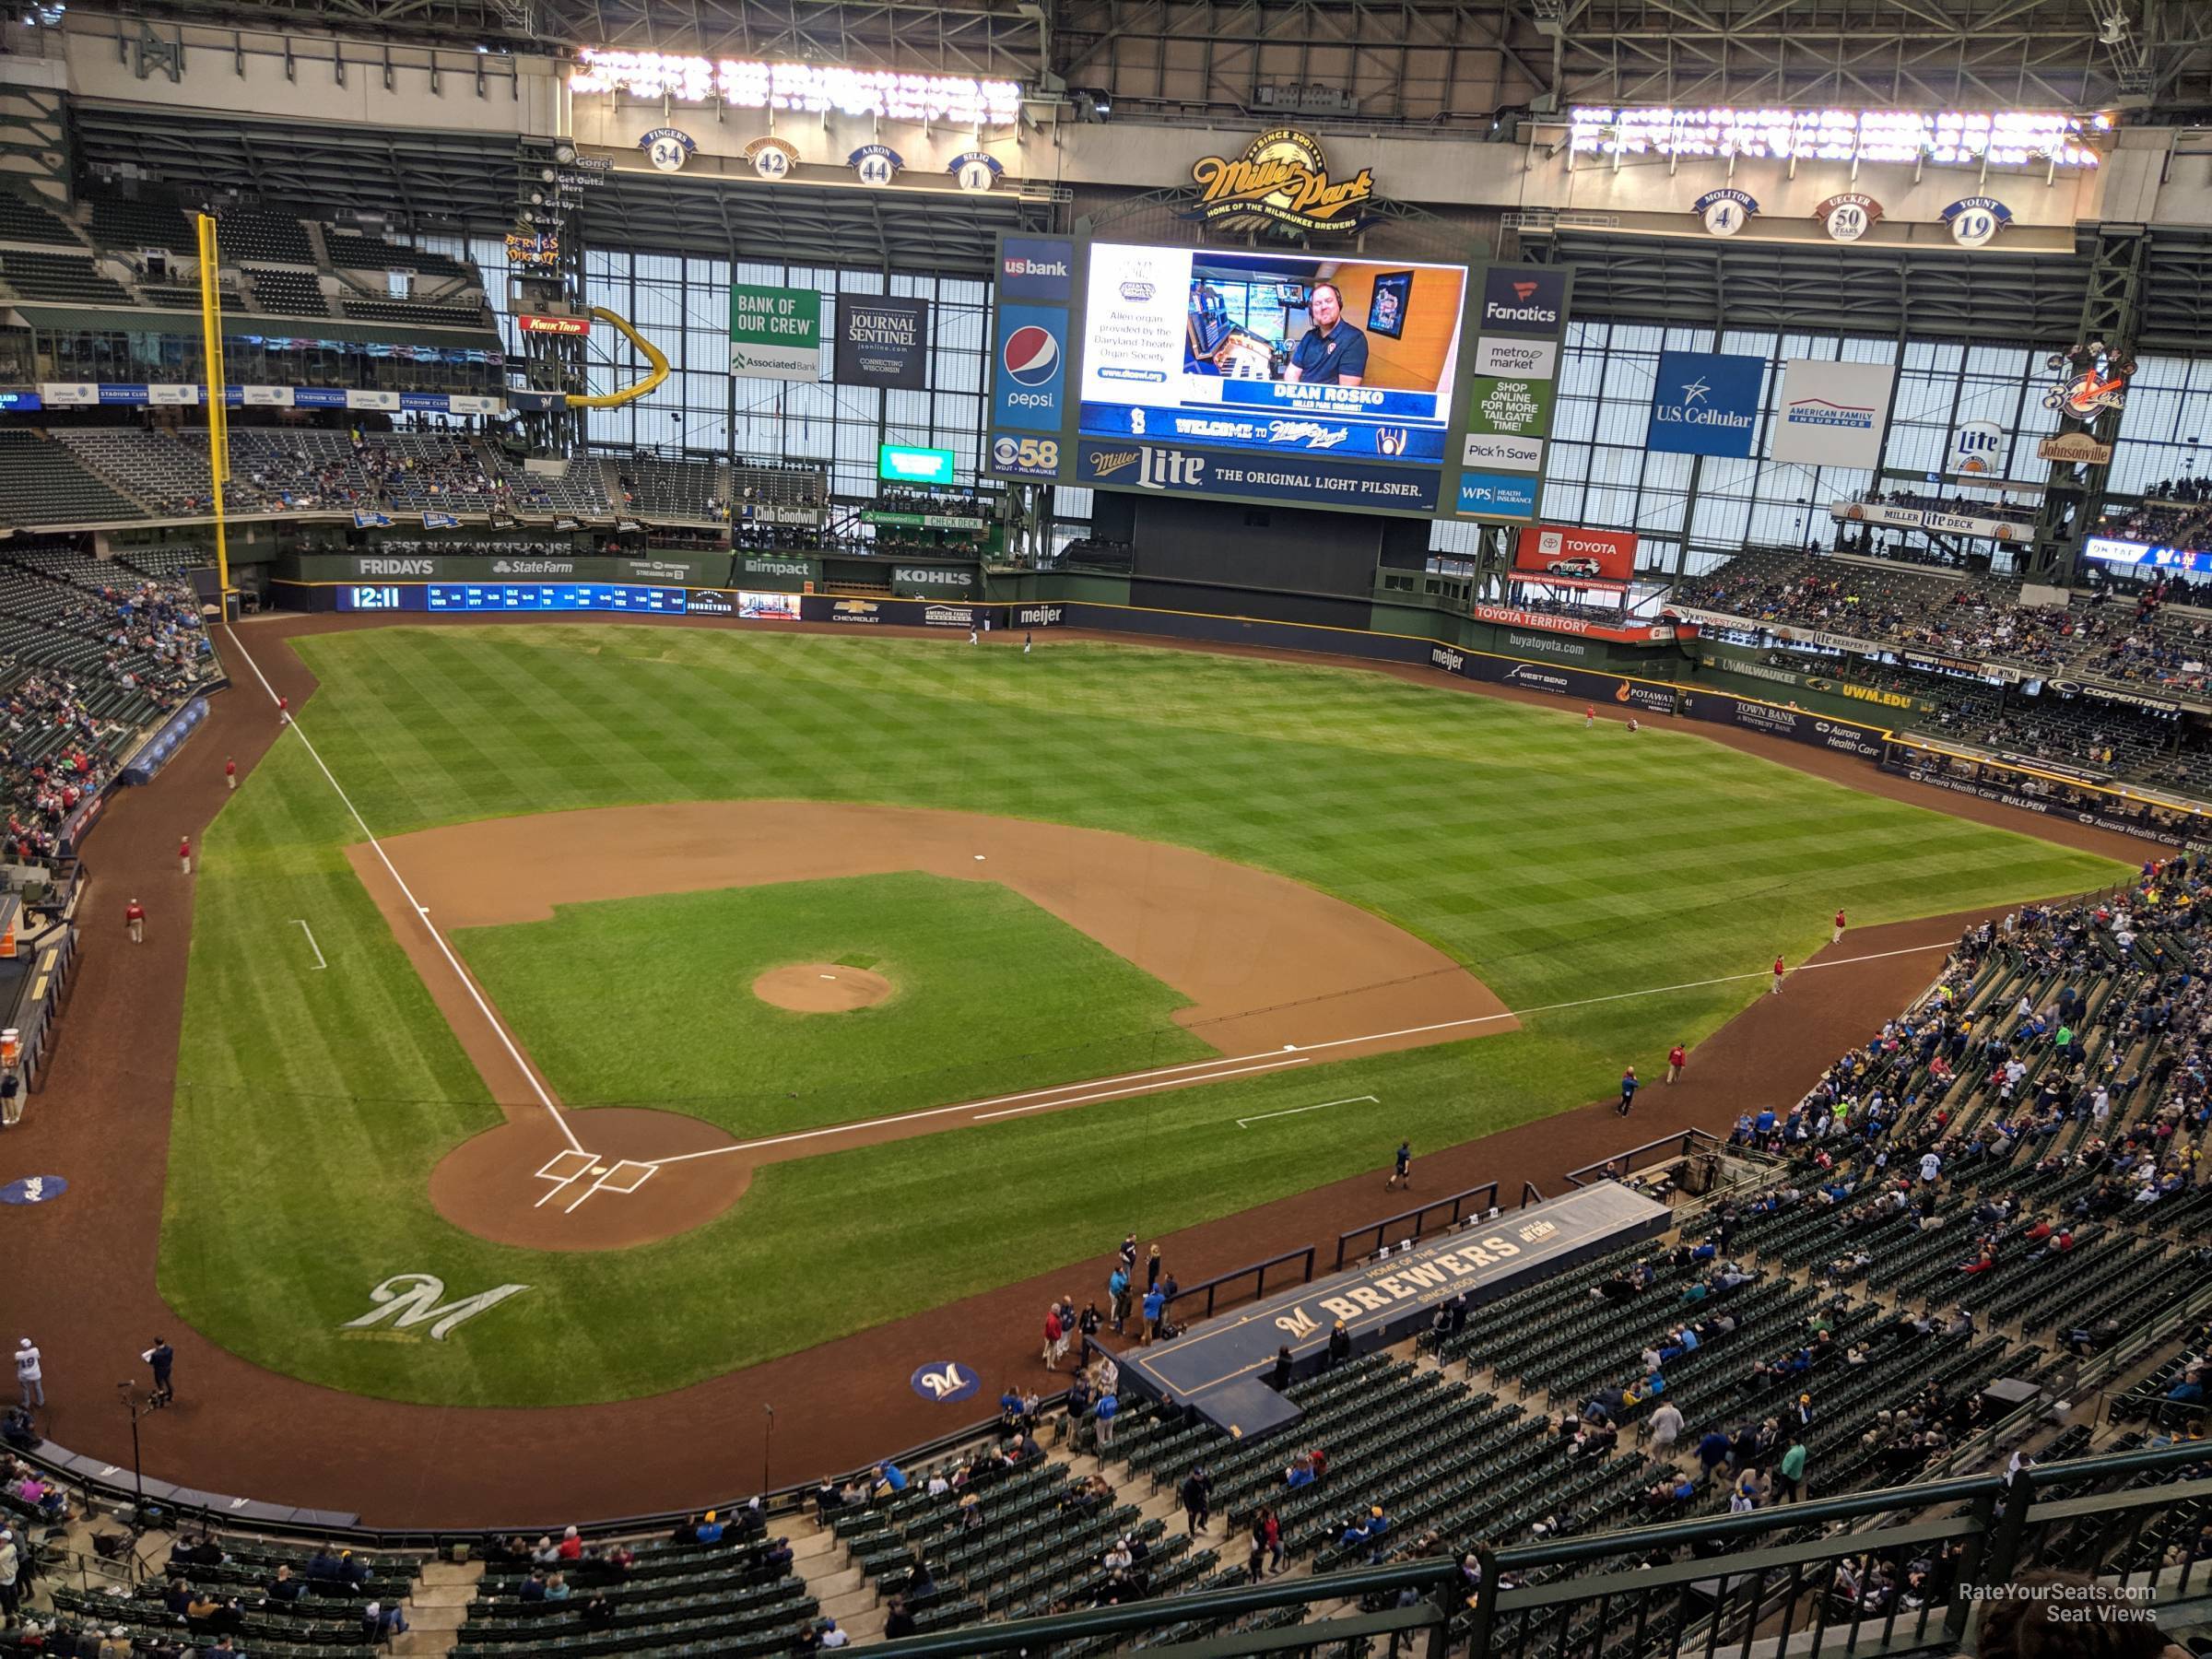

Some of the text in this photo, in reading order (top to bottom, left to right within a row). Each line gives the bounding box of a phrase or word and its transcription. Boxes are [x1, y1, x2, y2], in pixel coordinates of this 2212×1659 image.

[649, 129, 687, 142] FINGERS
[1257, 132, 1314, 149] SINCE 2001
[751, 138, 793, 152] ROBINSON
[863, 146, 891, 158] AARON
[655, 145, 681, 164] 34
[759, 153, 784, 173] 42
[963, 152, 990, 162] SELIG
[863, 160, 888, 182] 44
[971, 170, 982, 189] 1
[558, 175, 605, 186] Get Outta
[561, 184, 584, 193] Here
[1194, 156, 1374, 215] Miller Park
[562, 201, 574, 210] Up
[1705, 190, 1750, 205] MOLITOR
[1830, 194, 1871, 206] UECKER
[1959, 198, 1998, 209] YOUNT
[1207, 203, 1357, 229] HOME OF THE MILWAUKEE BREWERS
[1715, 206, 1730, 228] 4
[1835, 209, 1860, 228] 50
[1959, 216, 1991, 238] 19
[738, 295, 795, 315] BANK OF
[1487, 301, 1556, 322] Fanatics
[738, 314, 766, 332] OUR
[850, 314, 917, 332] JOURNAL
[1110, 312, 1134, 321] Allen
[849, 328, 916, 346] SENTINEL
[1100, 324, 1171, 335] provided by the
[857, 343, 908, 352] jsonline.com
[1094, 335, 1174, 348] Dairyland Theatre
[1100, 348, 1165, 362] Organ Society
[1491, 347, 1529, 359] metro
[747, 357, 818, 371] Associated Bank
[859, 358, 903, 367] CONNECTING
[863, 365, 900, 373] WISCONSIN
[1489, 359, 1535, 370] market
[1274, 383, 1384, 406] DEAN ROSKO
[1497, 382, 1528, 393] SHOP
[1008, 392, 1052, 408] pepsi
[1481, 400, 1539, 413] FOR MORE
[1491, 392, 1532, 404] ONLINE
[1484, 410, 1534, 423] TAILGATE
[1656, 405, 1752, 429] U.S. Cellular
[1790, 407, 1874, 420] AMERICAN FAMILY
[1175, 418, 1267, 439] WELCOME TO
[1493, 420, 1522, 431] TIME!
[1794, 417, 1865, 428] INSURANCE
[1958, 430, 1998, 454] Lite
[1018, 439, 1059, 469] 58
[1469, 445, 1494, 457] Pick
[1506, 448, 1537, 460] Save
[2041, 442, 2108, 462] Johnsonville
[1018, 466, 1057, 475] MILWAUKEE
[1090, 446, 1205, 489] Miller Lite
[1215, 468, 1422, 498] THE ORIGINAL LIGHT PILSNER.
[1463, 487, 1491, 500] WPS
[1497, 496, 1532, 504] INSURANCE
[755, 507, 818, 524] Club Goodwill
[876, 514, 908, 523] Associated
[931, 517, 978, 528] CHECK DECK
[1884, 511, 1973, 529] MILLER Lite DECK
[1567, 540, 1617, 555] TOYOTA
[360, 559, 434, 574] FRIDAYS
[757, 559, 809, 576] impact
[895, 569, 972, 584] KOHL'S
[353, 587, 399, 607] 12:11
[688, 603, 732, 611] JOURNEYMAN
[833, 615, 879, 623] CHEVROLET
[1021, 604, 1062, 628] meijer
[1477, 606, 1589, 633] TOYOTA TERRITORY
[1510, 633, 1584, 655] buyatoyota.com
[1813, 631, 1863, 649] Lite BEERPEN
[1432, 648, 1464, 670] meijer
[1904, 653, 2018, 679] WISCONSIN'S RADIO STATION WTMJ
[1520, 672, 1568, 686] WEST BEND
[1843, 684, 1912, 708] UWM.EDU
[1736, 702, 1796, 724] TOWN BANK
[1742, 715, 1772, 727] WINTRUST
[1775, 724, 1792, 733] BANK
[1830, 725, 1861, 739] Aurora
[1828, 736, 1877, 757] Health Care
[1924, 775, 2047, 813] Aurora Health Care BULLPEN
[2094, 818, 2181, 846] Aurora Health Care
[1531, 1221, 1556, 1236] CREW
[1365, 1248, 1439, 1279] HOME OF THE
[1319, 1237, 1521, 1321] BREWERS
[1418, 1277, 1476, 1303] SINCE 2001
[341, 1273, 531, 1341] M
[1276, 1306, 1322, 1341] M
[21, 1357, 35, 1369] 19
[922, 1363, 970, 1400] M
